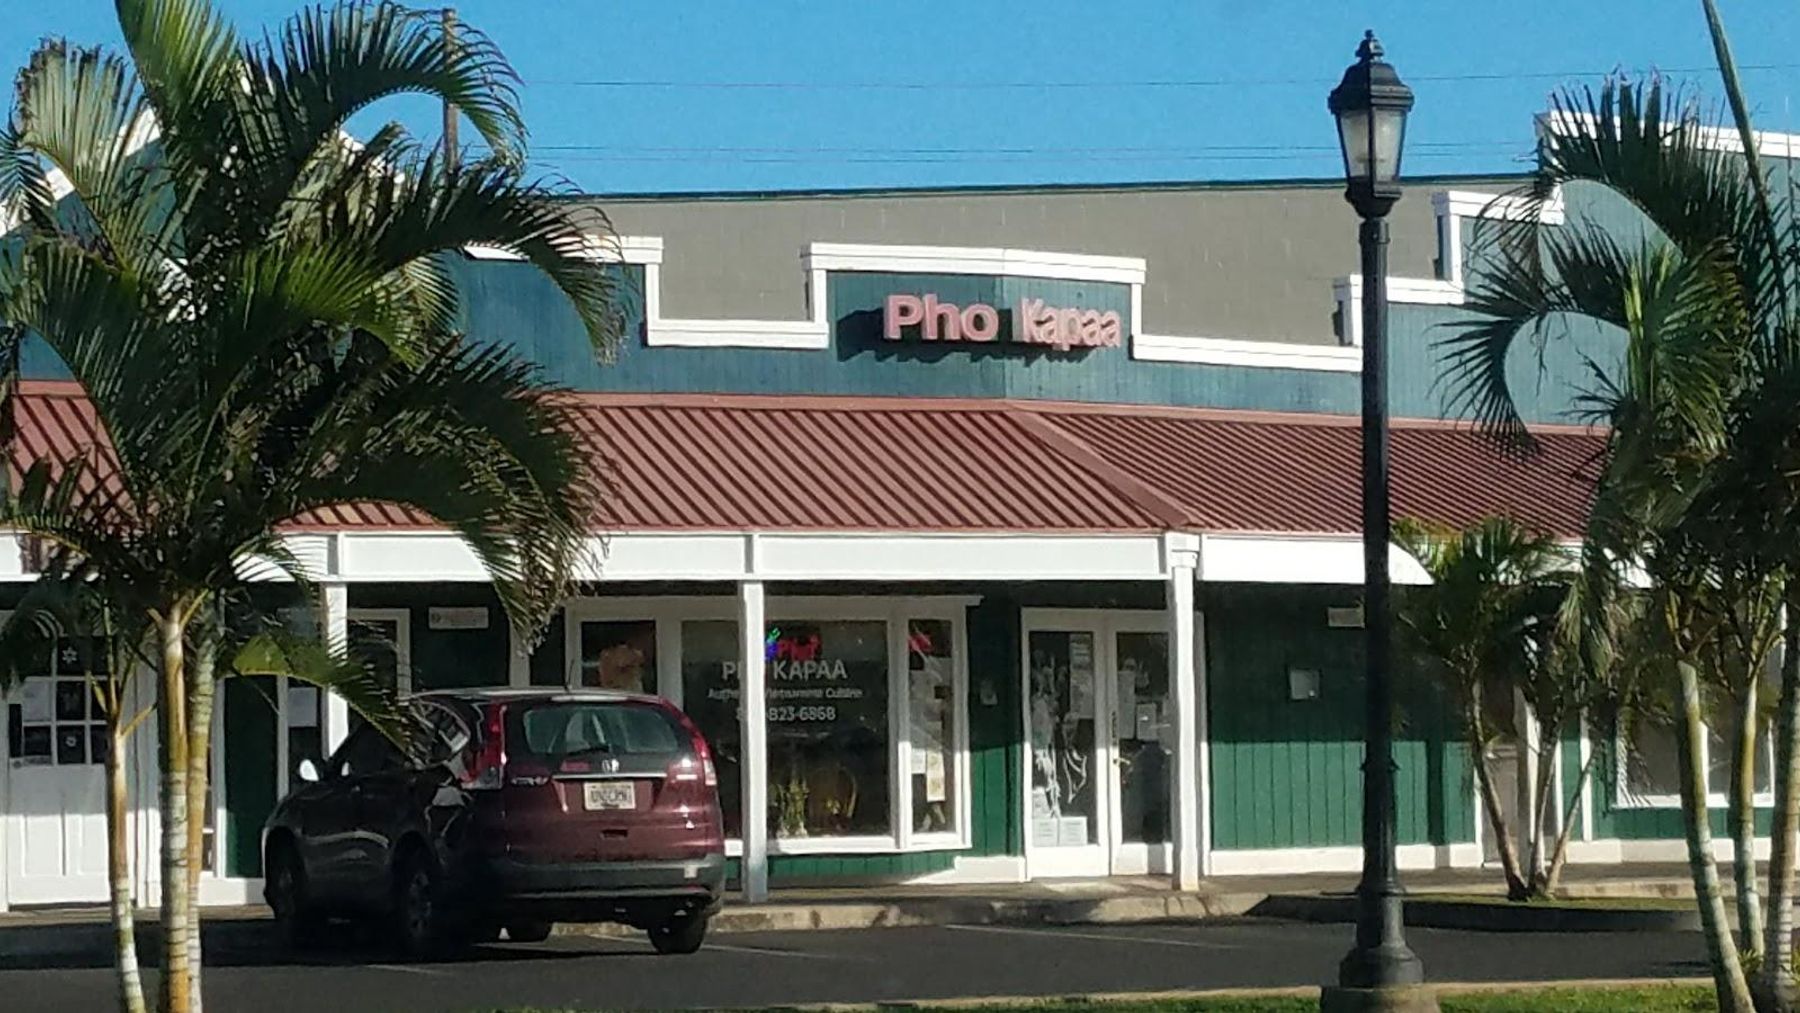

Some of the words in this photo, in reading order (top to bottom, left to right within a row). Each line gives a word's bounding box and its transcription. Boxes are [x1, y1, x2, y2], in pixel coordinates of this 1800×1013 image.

[885, 294, 999, 342] Pho
[1016, 298, 1121, 350] Kapaa
[773, 660, 848, 680] KAPAA
